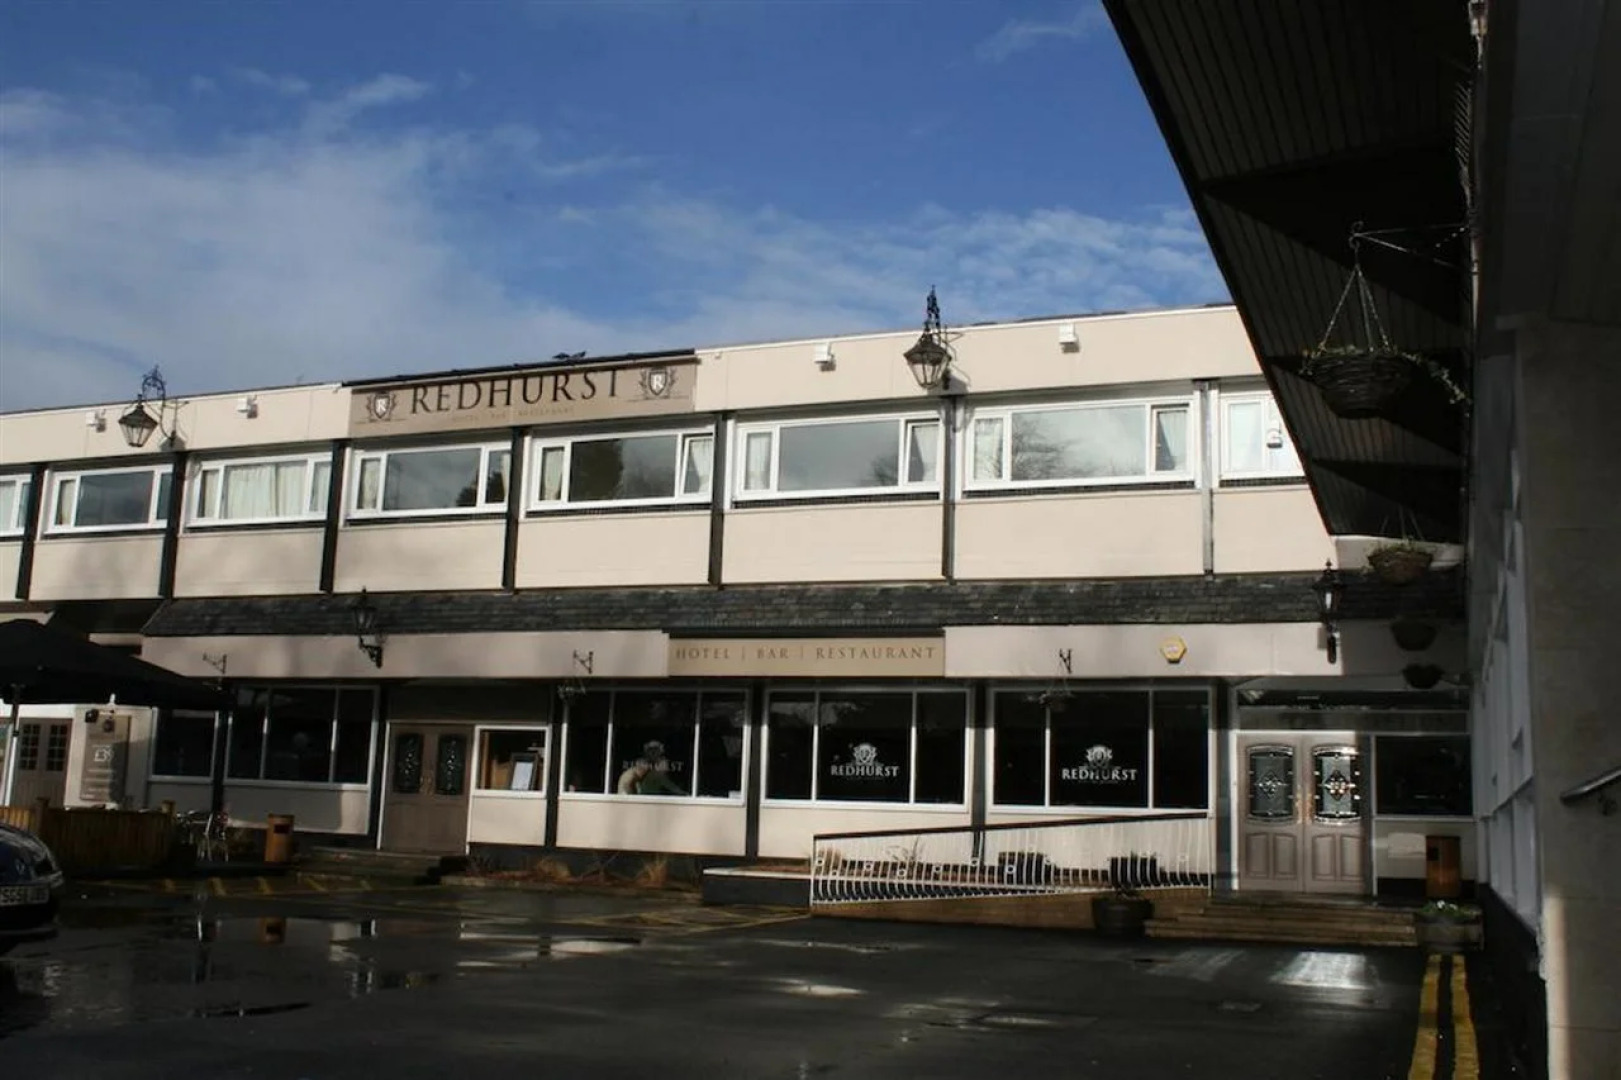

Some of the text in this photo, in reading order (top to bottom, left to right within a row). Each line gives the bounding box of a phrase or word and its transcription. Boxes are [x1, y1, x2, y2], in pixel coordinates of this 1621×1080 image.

[652, 374, 663, 390] R
[411, 370, 619, 414] REDHURST
[675, 645, 936, 660] HOTEL BAR RESTAURANT
[830, 765, 899, 777] REDHURST
[1062, 768, 1137, 780] REDHURST
